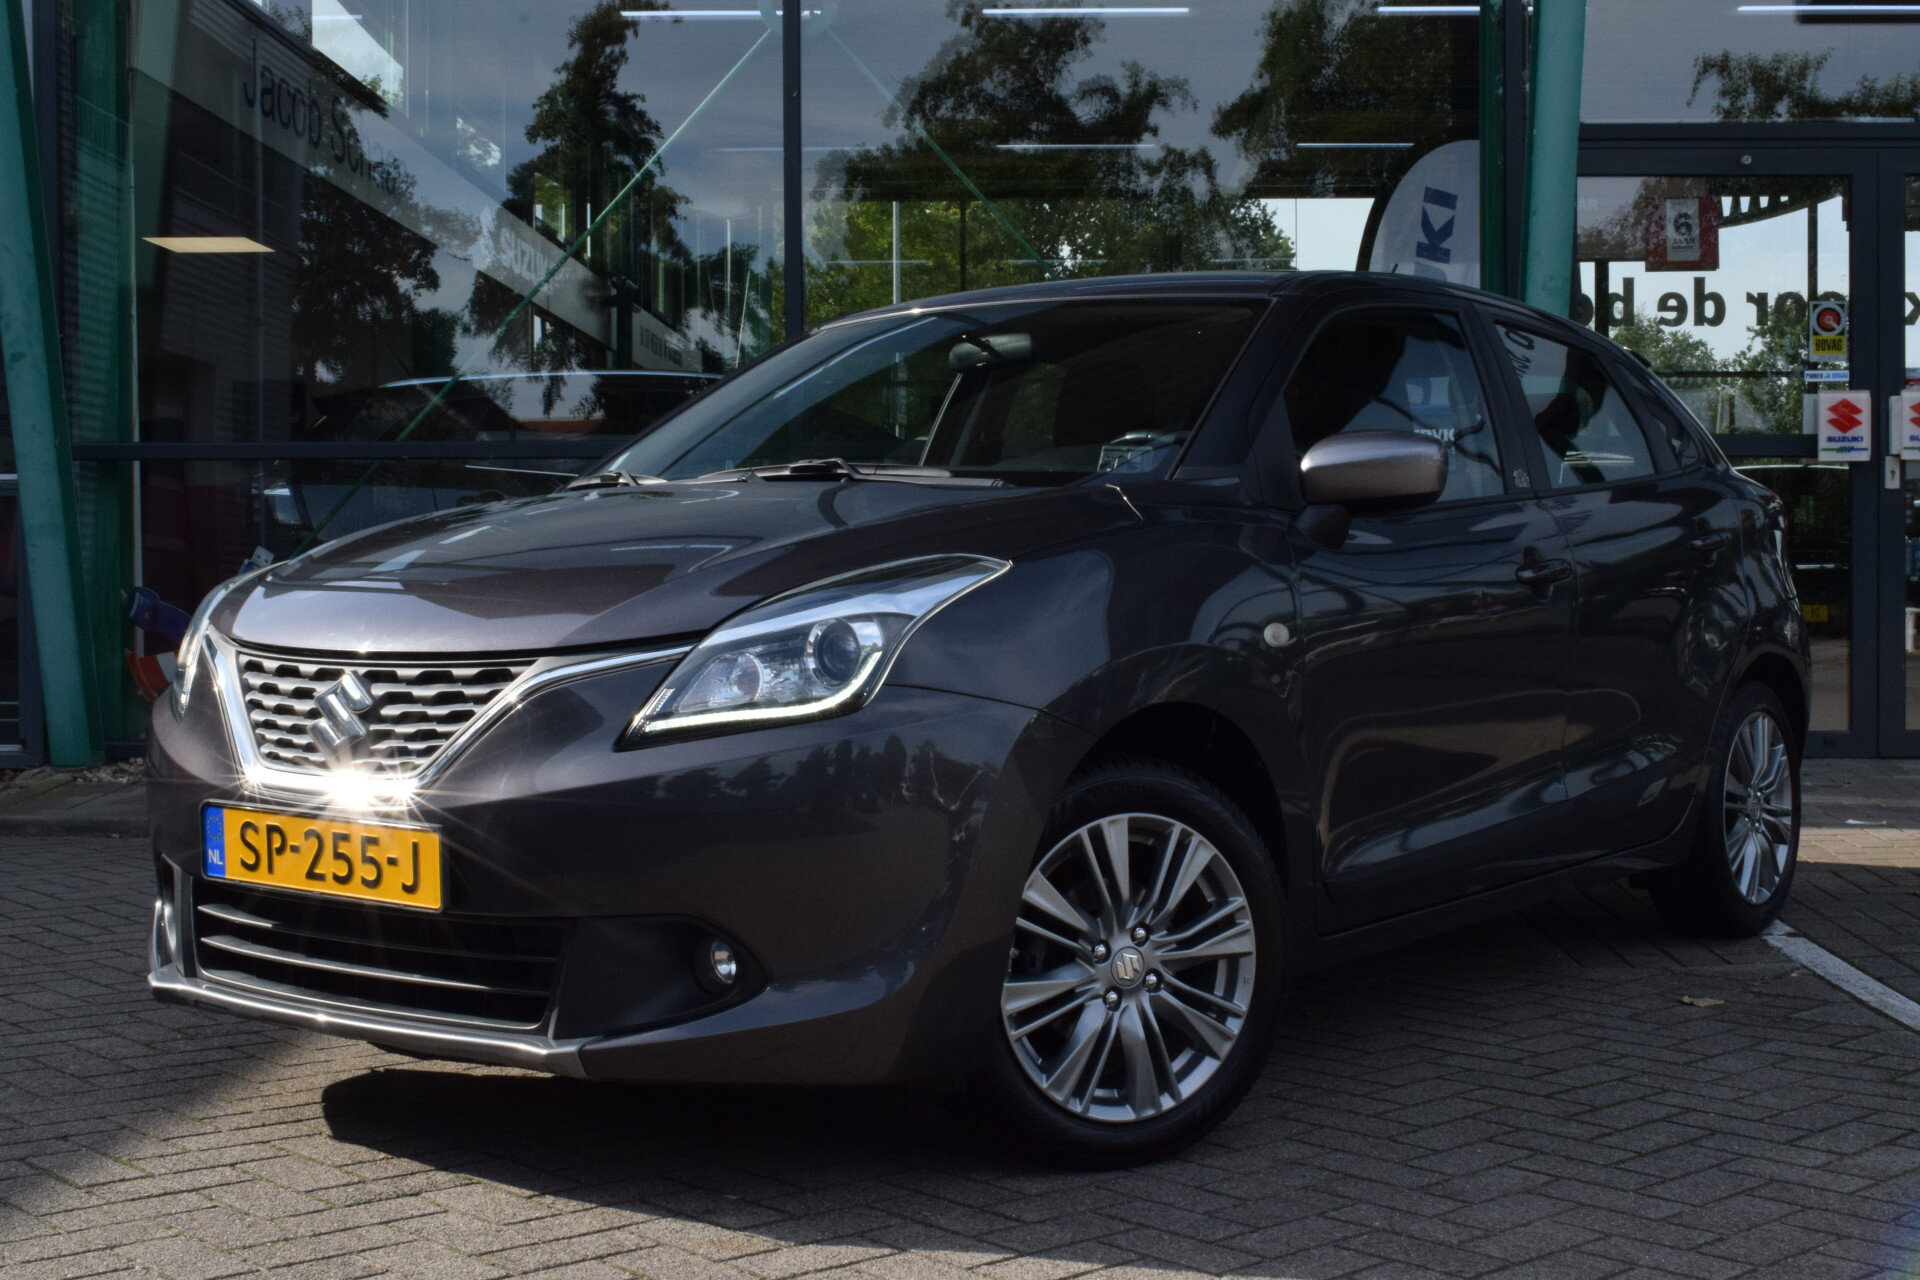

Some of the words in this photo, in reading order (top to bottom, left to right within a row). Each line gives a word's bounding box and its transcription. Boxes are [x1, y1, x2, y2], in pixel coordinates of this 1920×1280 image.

[243, 38, 322, 149] Jacob
[1815, 338, 1843, 352] BOVAG
[208, 849, 223, 865] NL
[239, 821, 419, 894] SP-255-J
